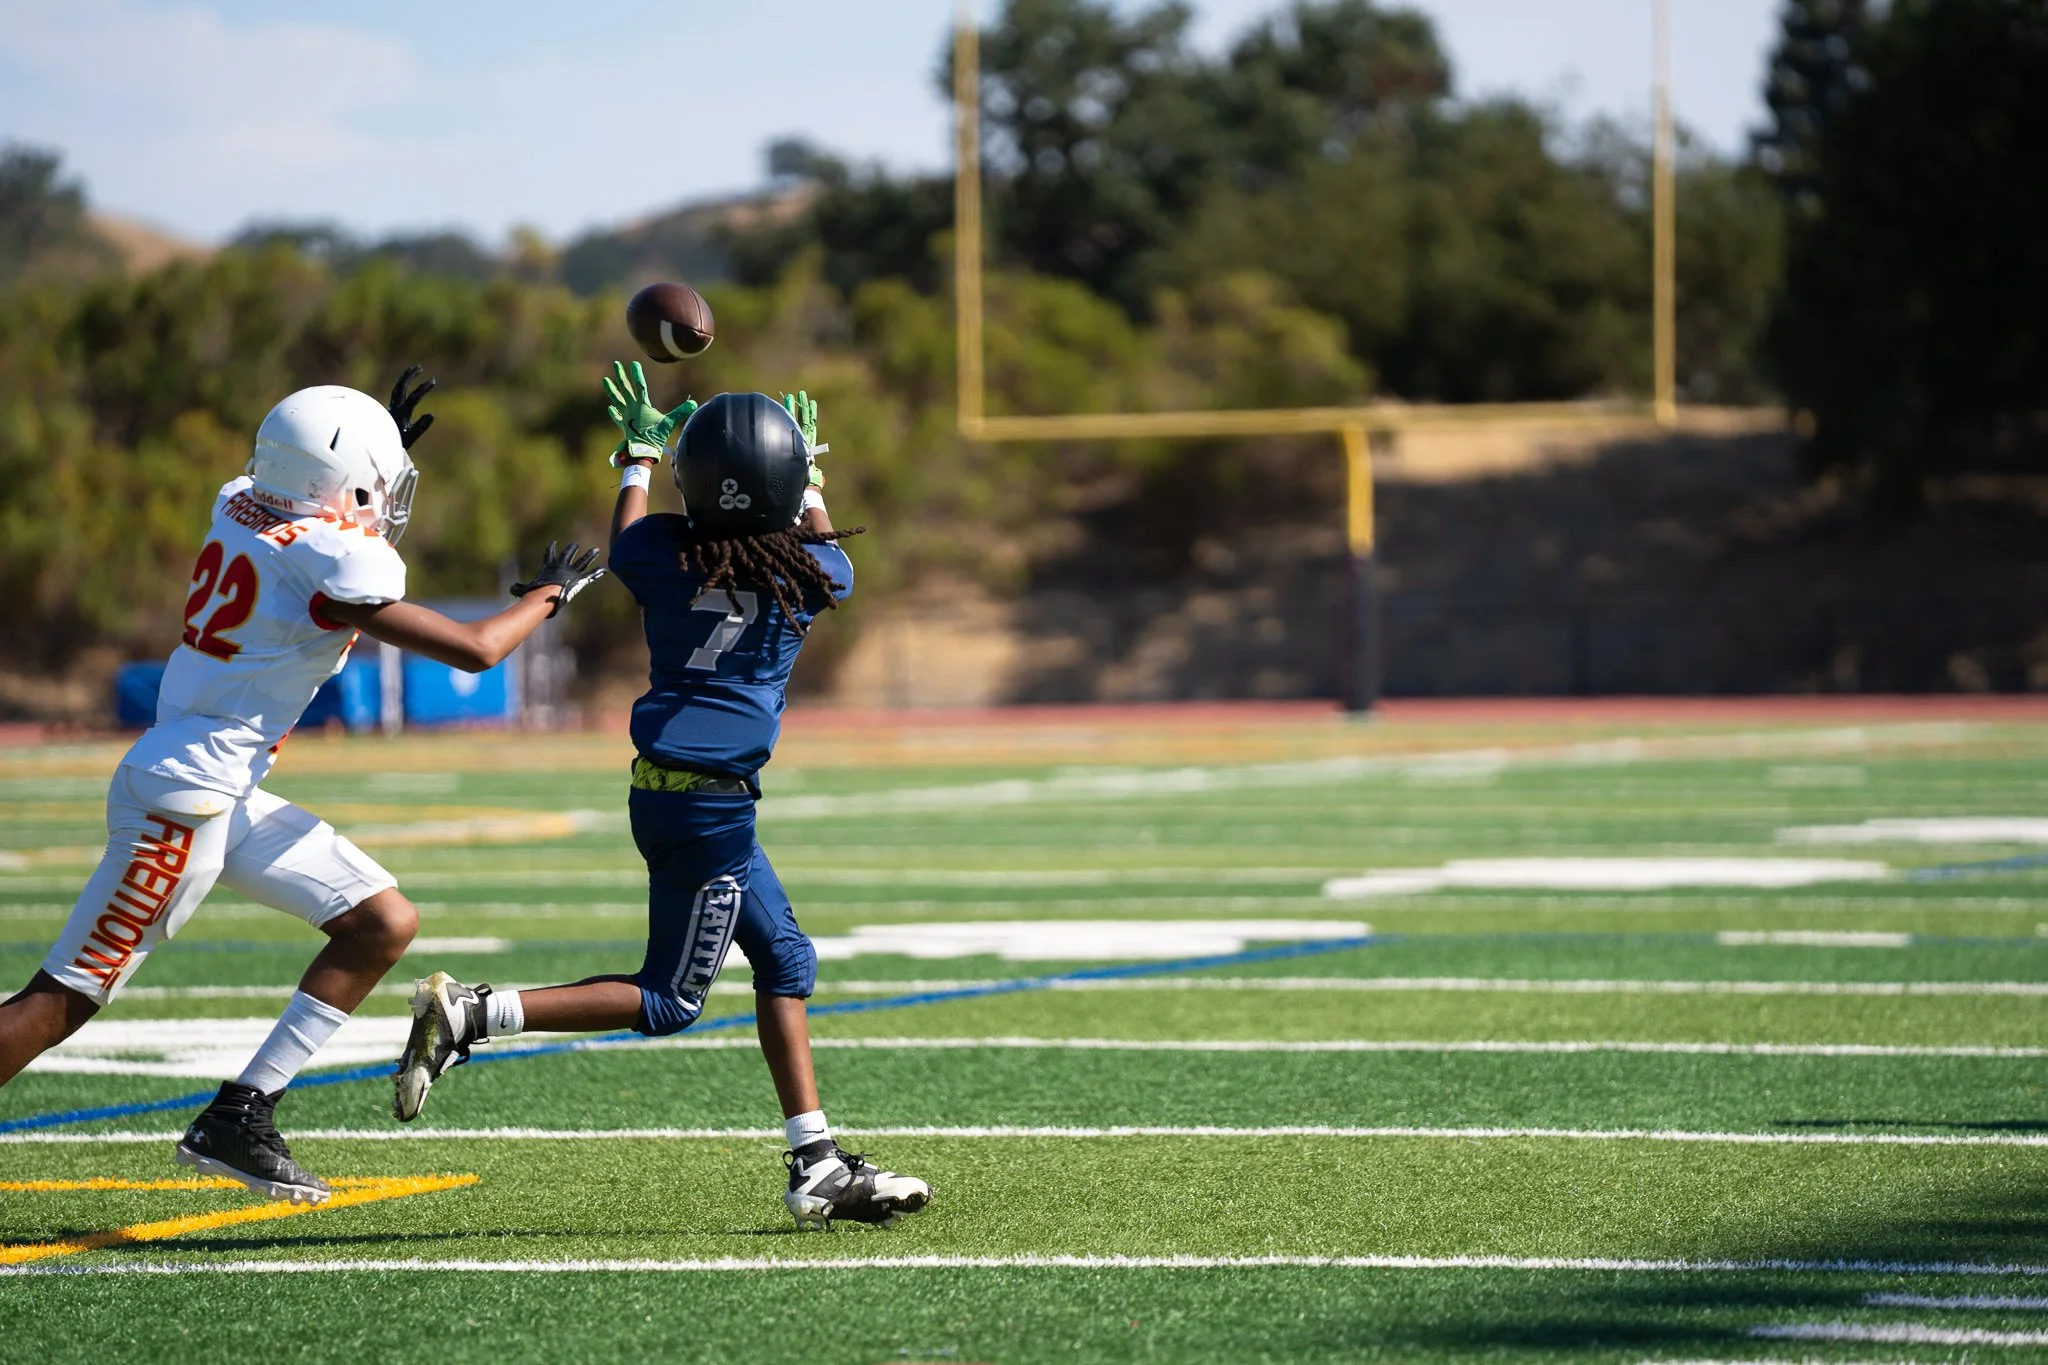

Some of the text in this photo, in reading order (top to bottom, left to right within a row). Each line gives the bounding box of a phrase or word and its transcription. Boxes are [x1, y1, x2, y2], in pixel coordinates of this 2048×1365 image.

[220, 491, 309, 547] FIREBIRDS
[182, 539, 260, 664] 22
[685, 586, 759, 672] 7
[72, 813, 195, 991] FREMONT
